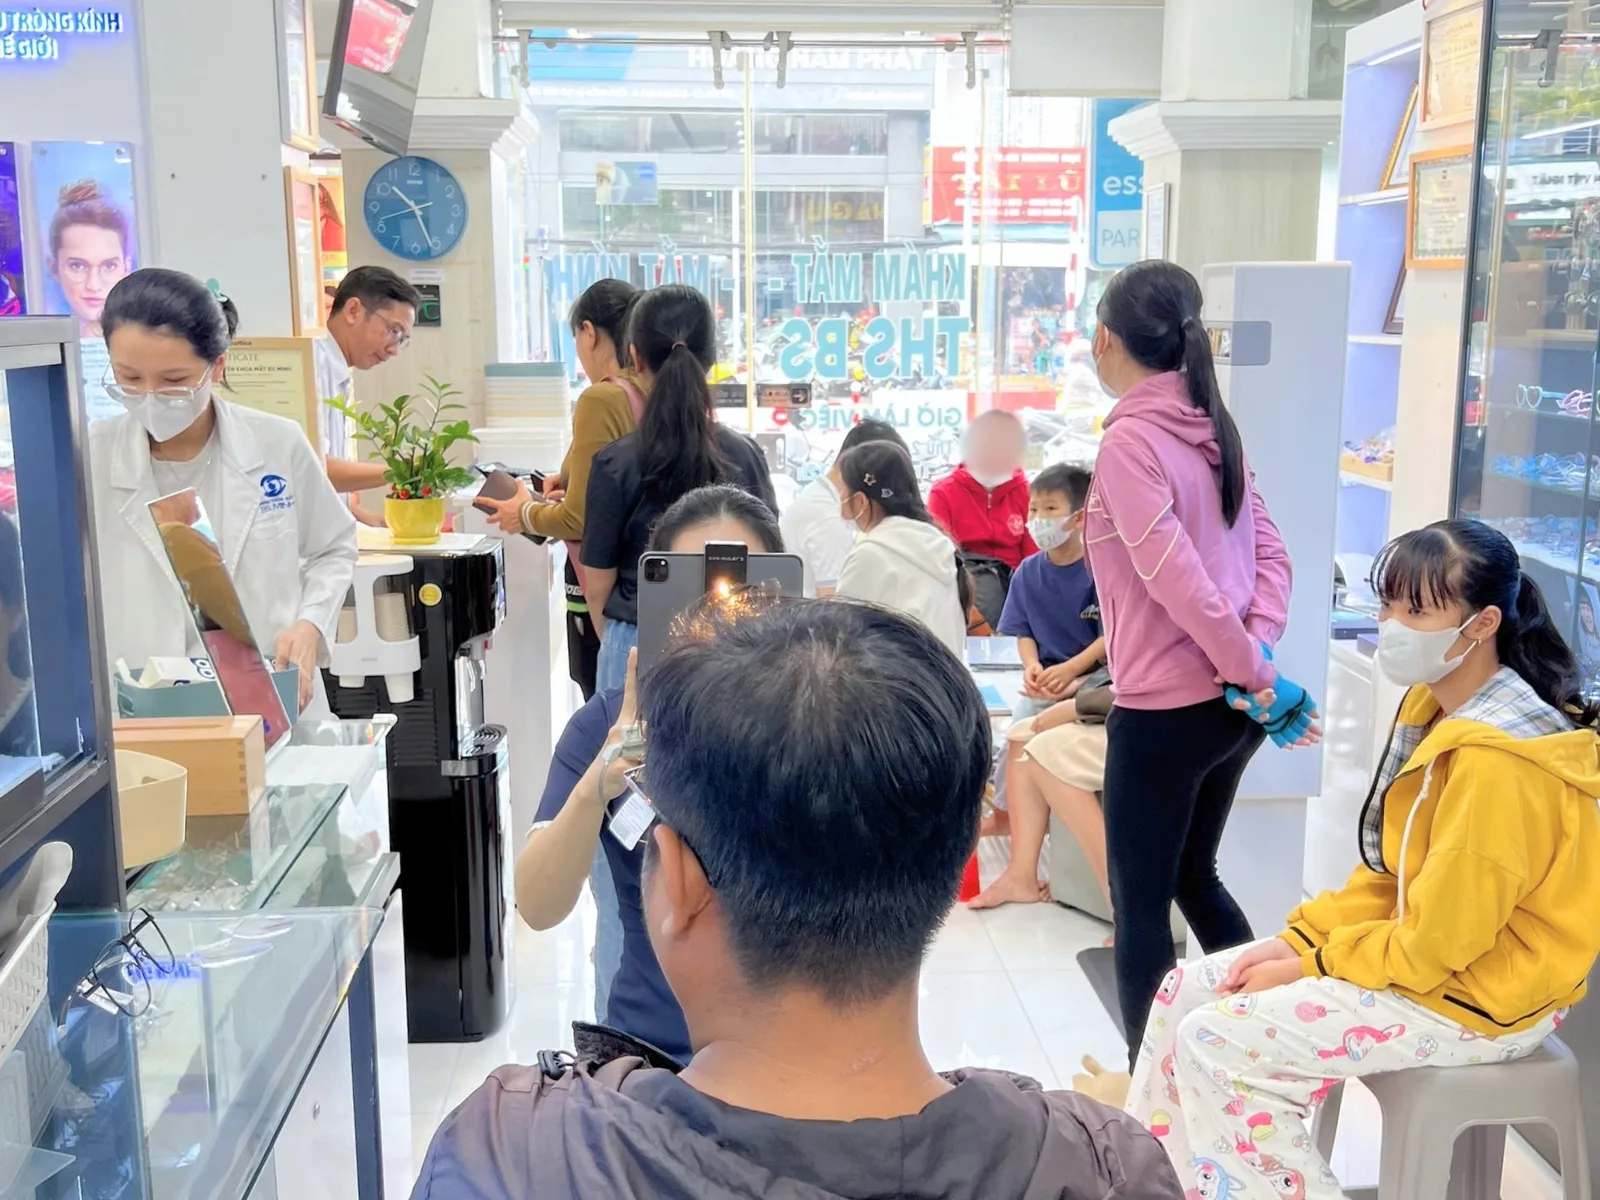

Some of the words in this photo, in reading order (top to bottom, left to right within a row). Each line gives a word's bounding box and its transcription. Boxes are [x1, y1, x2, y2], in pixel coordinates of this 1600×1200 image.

[75, 7, 123, 32] KÍNH
[17, 34, 58, 59] GIỚI
[791, 49, 846, 70] NAM
